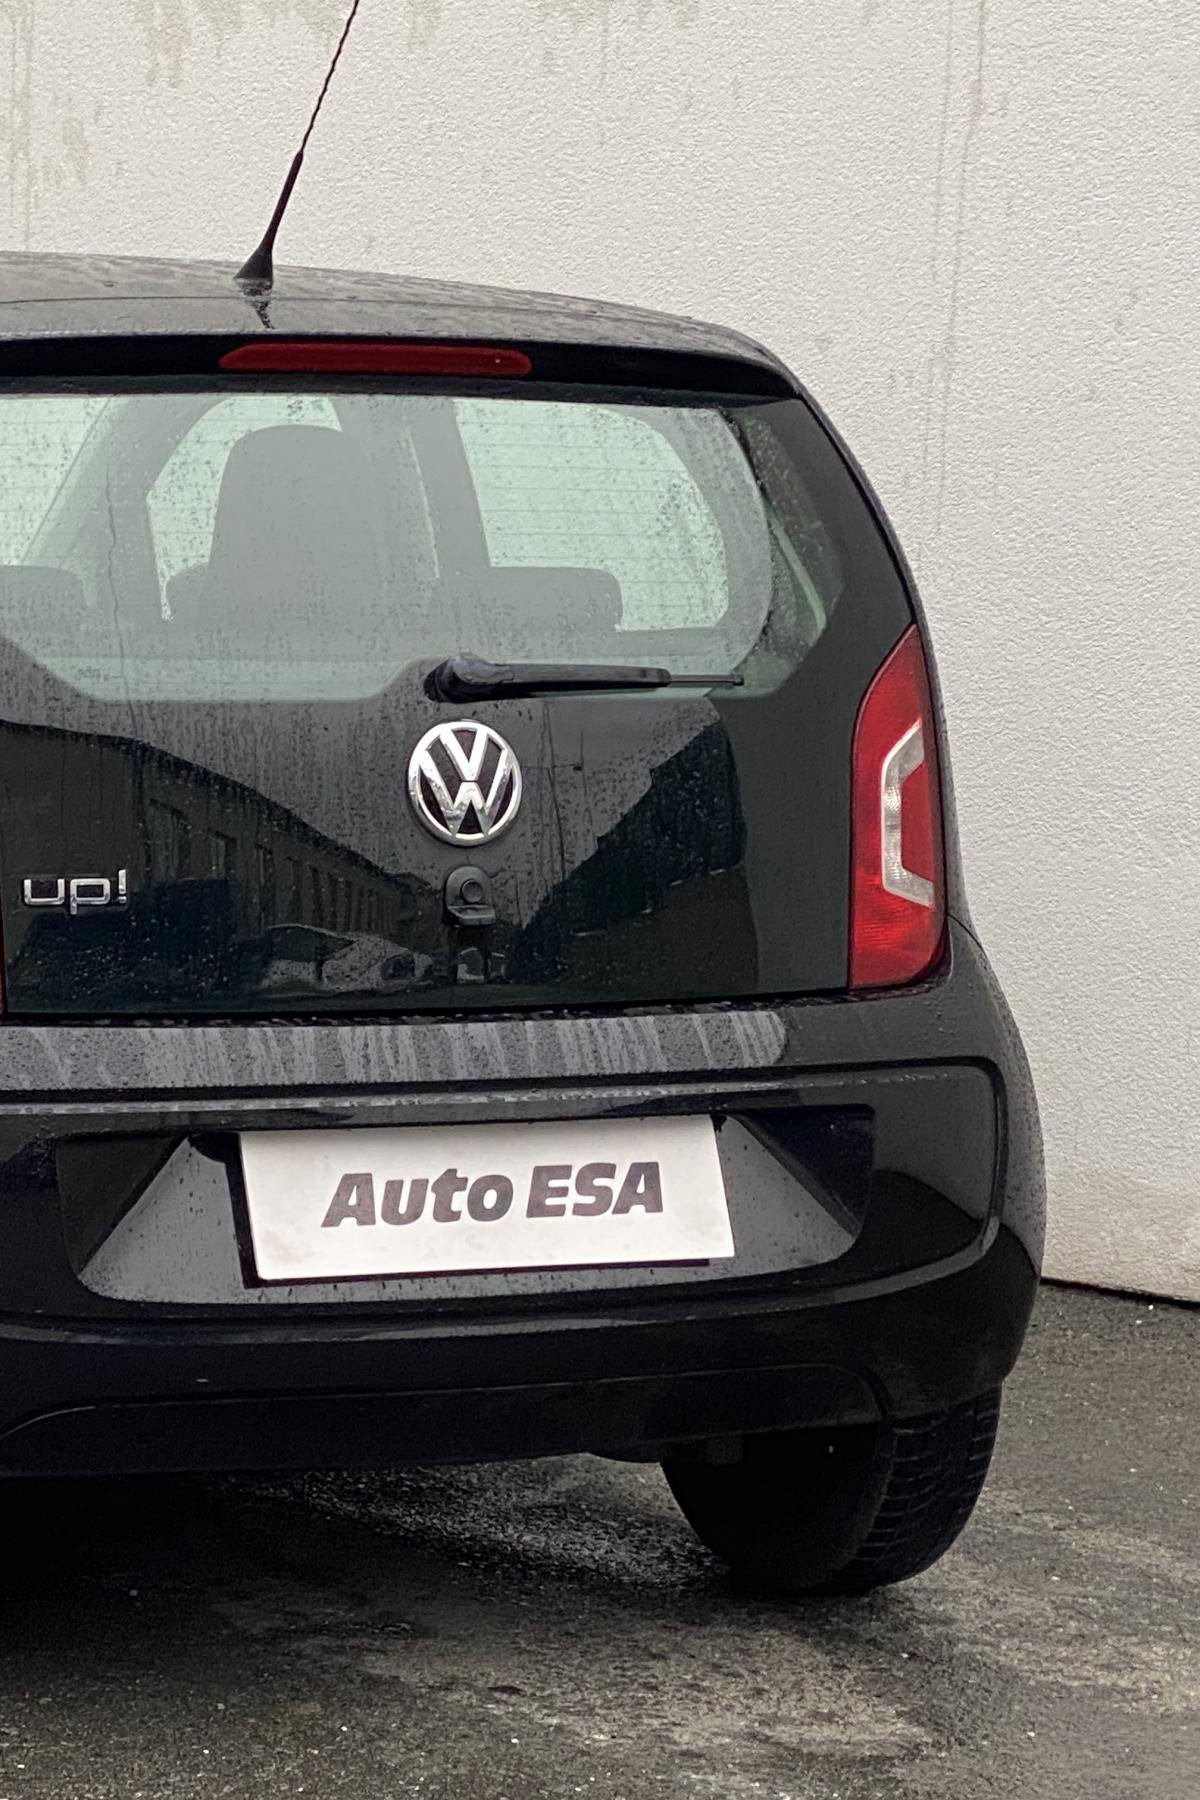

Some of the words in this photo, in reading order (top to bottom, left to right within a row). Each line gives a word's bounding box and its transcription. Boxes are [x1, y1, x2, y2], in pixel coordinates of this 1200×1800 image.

[408, 721, 520, 841] VW
[23, 869, 127, 915] up!
[321, 1168, 514, 1228] Auto
[526, 1161, 663, 1219] ESA
